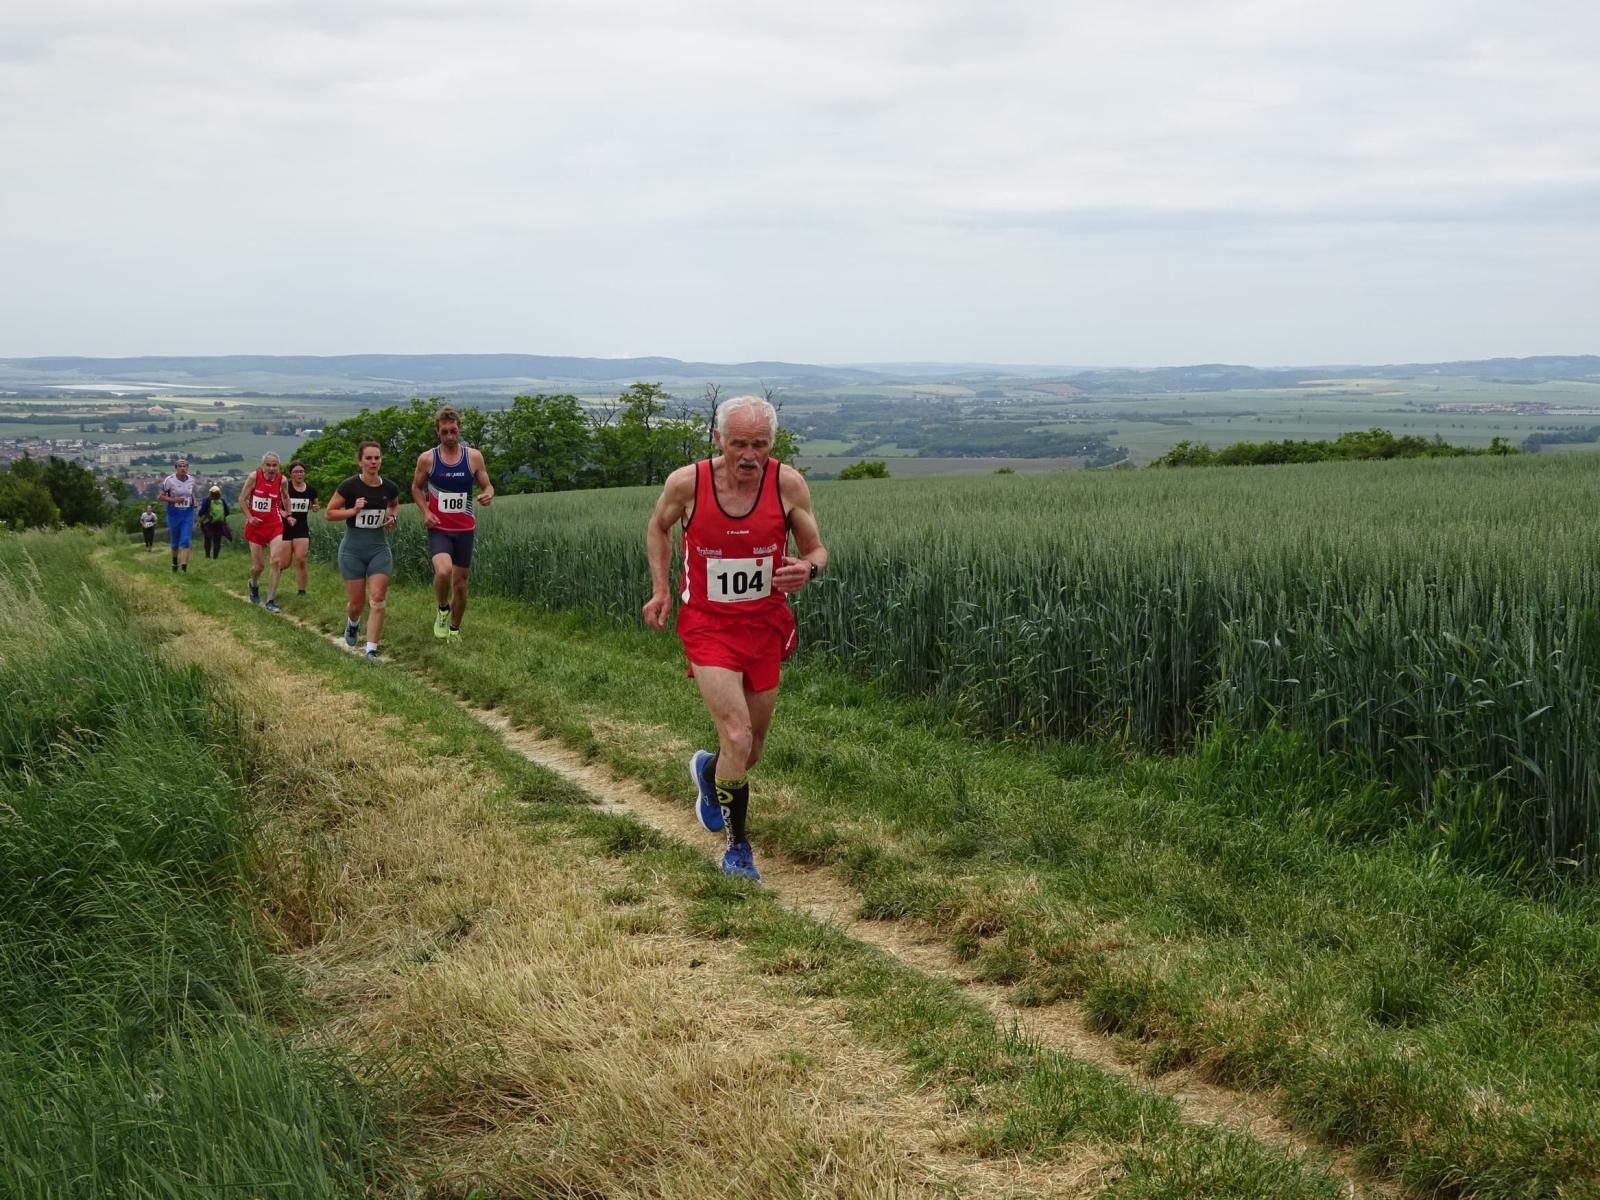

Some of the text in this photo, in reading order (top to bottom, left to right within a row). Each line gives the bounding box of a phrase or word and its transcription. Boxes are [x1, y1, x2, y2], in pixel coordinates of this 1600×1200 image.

[254, 501, 269, 510] 102
[291, 502, 306, 510] 116
[442, 498, 463, 510] 108
[360, 514, 381, 526] 107
[716, 570, 764, 595] 104
